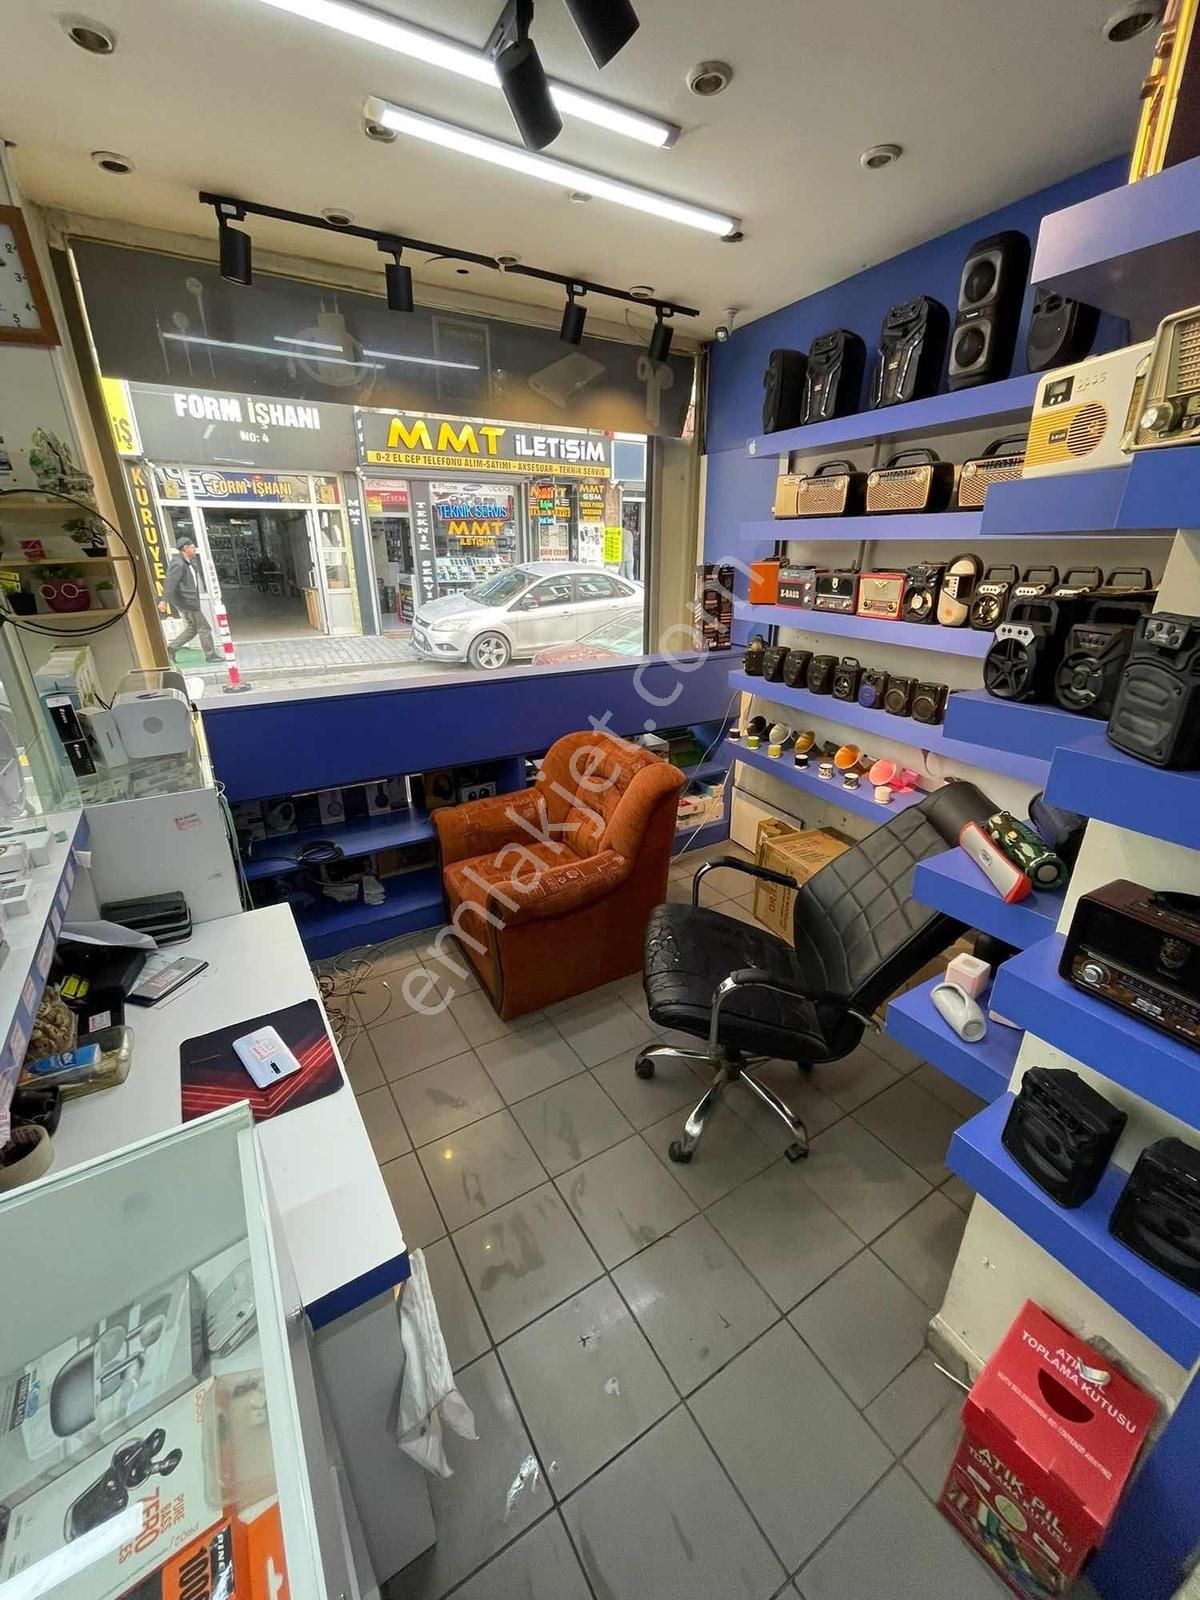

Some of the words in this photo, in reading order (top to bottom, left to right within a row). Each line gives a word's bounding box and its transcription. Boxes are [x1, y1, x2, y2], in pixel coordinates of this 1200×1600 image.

[174, 393, 242, 423] FORM
[247, 397, 320, 430] İŞHANI
[240, 430, 260, 443] NO:
[262, 432, 270, 443] 4
[387, 417, 506, 455] MMT
[515, 434, 605, 462] İLETİŞİM
[393, 454, 403, 463] EL
[404, 455, 421, 464] CEP
[424, 456, 462, 467] TELEFONU
[212, 480, 247, 494] FORM
[579, 484, 605, 493] MMT
[347, 499, 361, 526] MMT
[448, 520, 505, 536] MMT
[1022, 1330, 1078, 1386] TOPLAMA
[1081, 1384, 1137, 1434] KUTUSU
[978, 1448, 1024, 1496] ATIK
[968, 1445, 1020, 1499] TOPLAMA
[1023, 1500, 1072, 1553] KUTUSU
